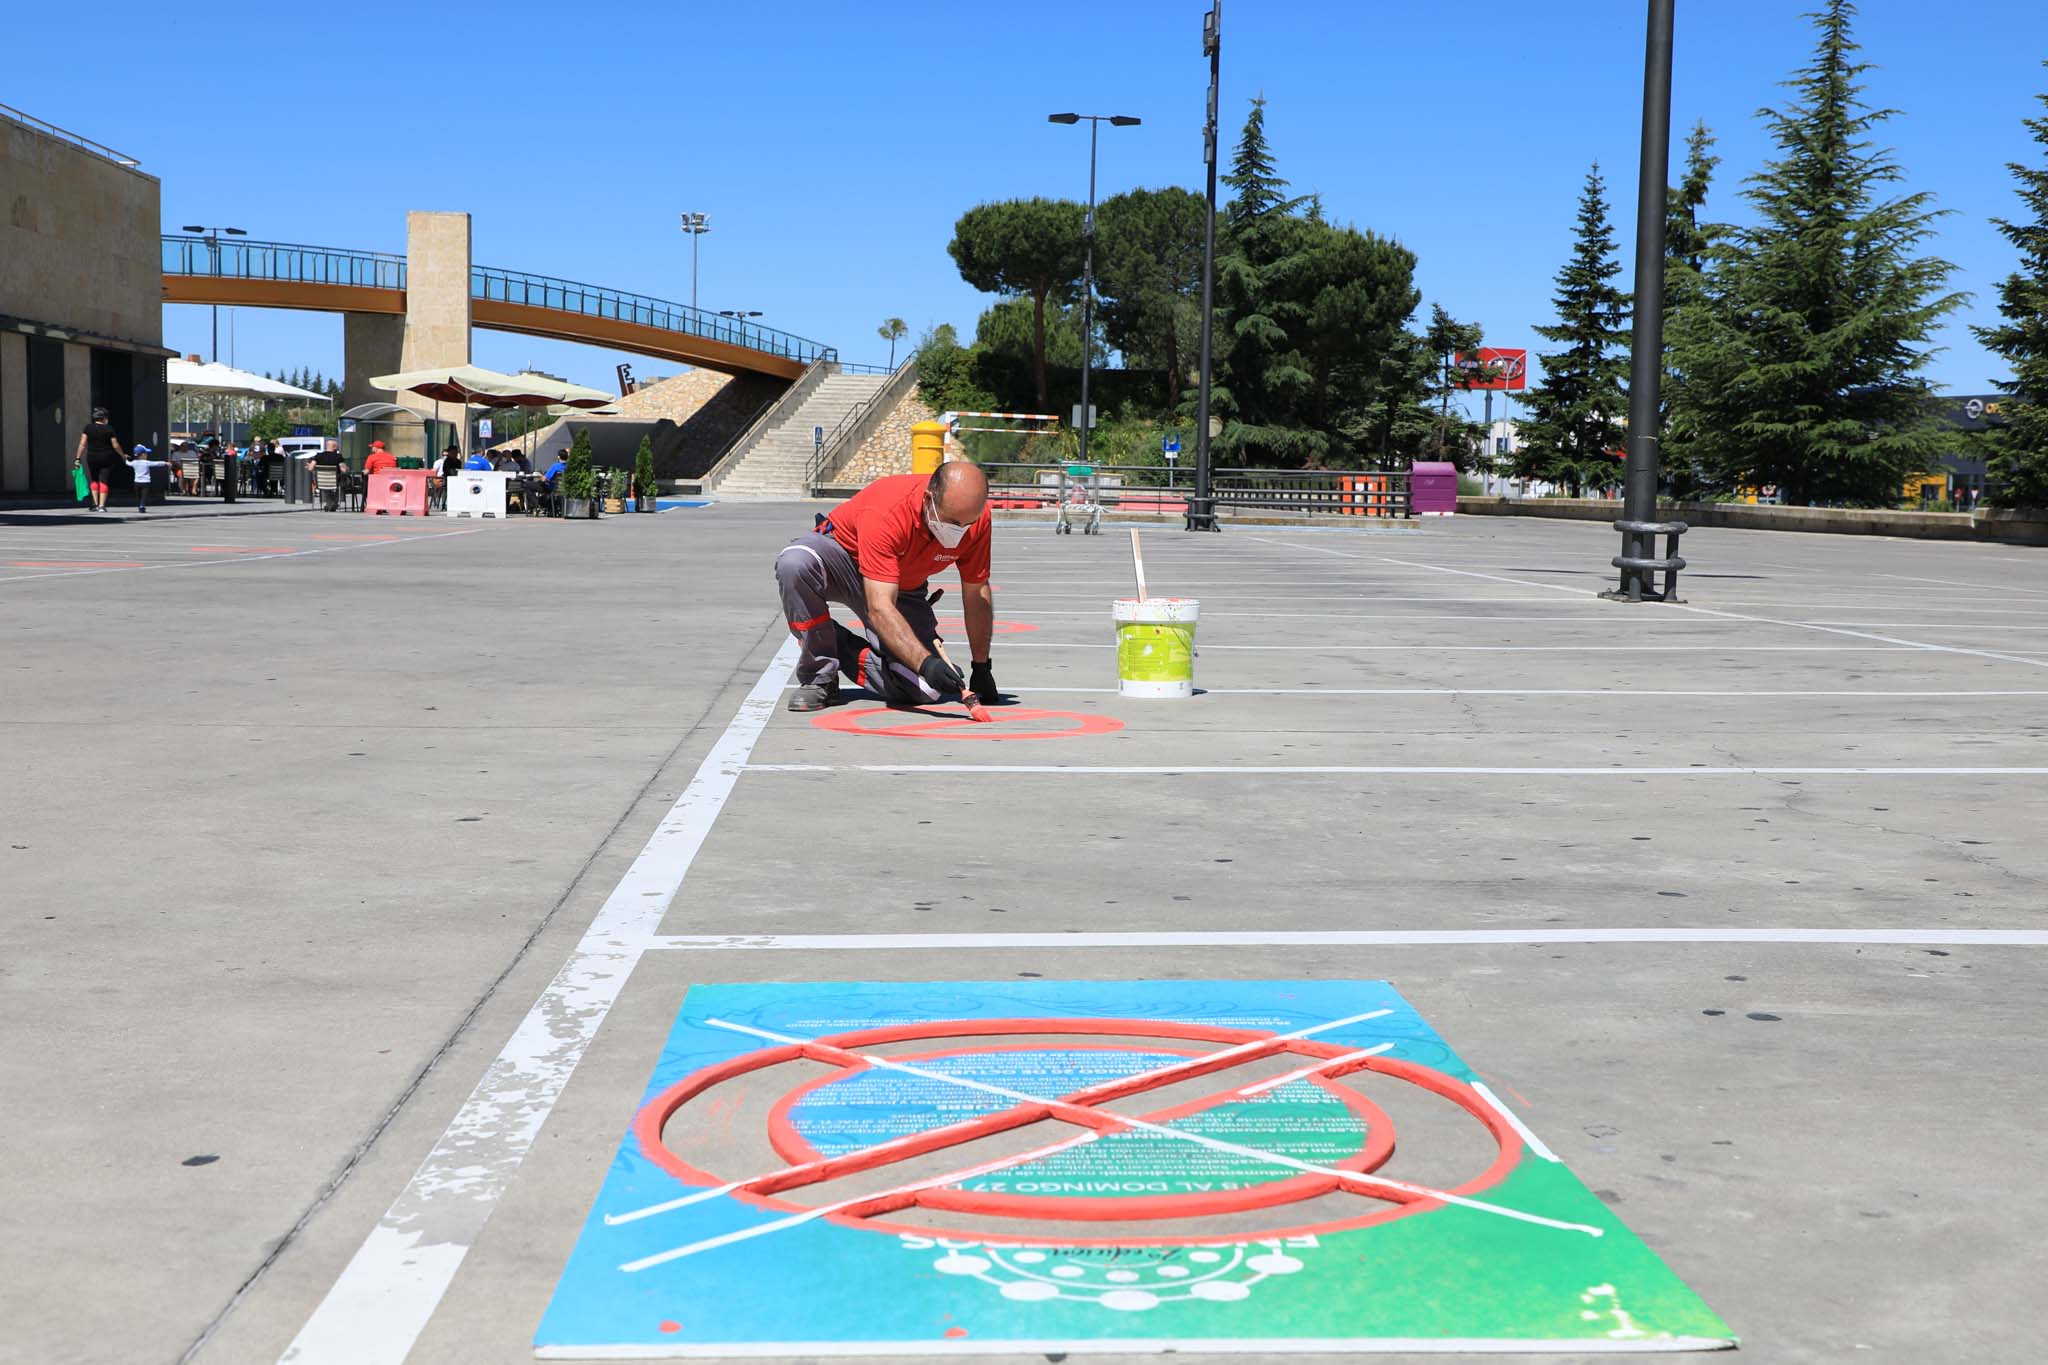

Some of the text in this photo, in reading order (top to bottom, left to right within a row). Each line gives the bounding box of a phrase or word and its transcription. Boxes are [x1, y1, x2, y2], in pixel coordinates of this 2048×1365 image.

[973, 1182, 1006, 1192] 27
[1016, 1182, 1169, 1192] DOMINGO
[1175, 1182, 1212, 1191] AL
